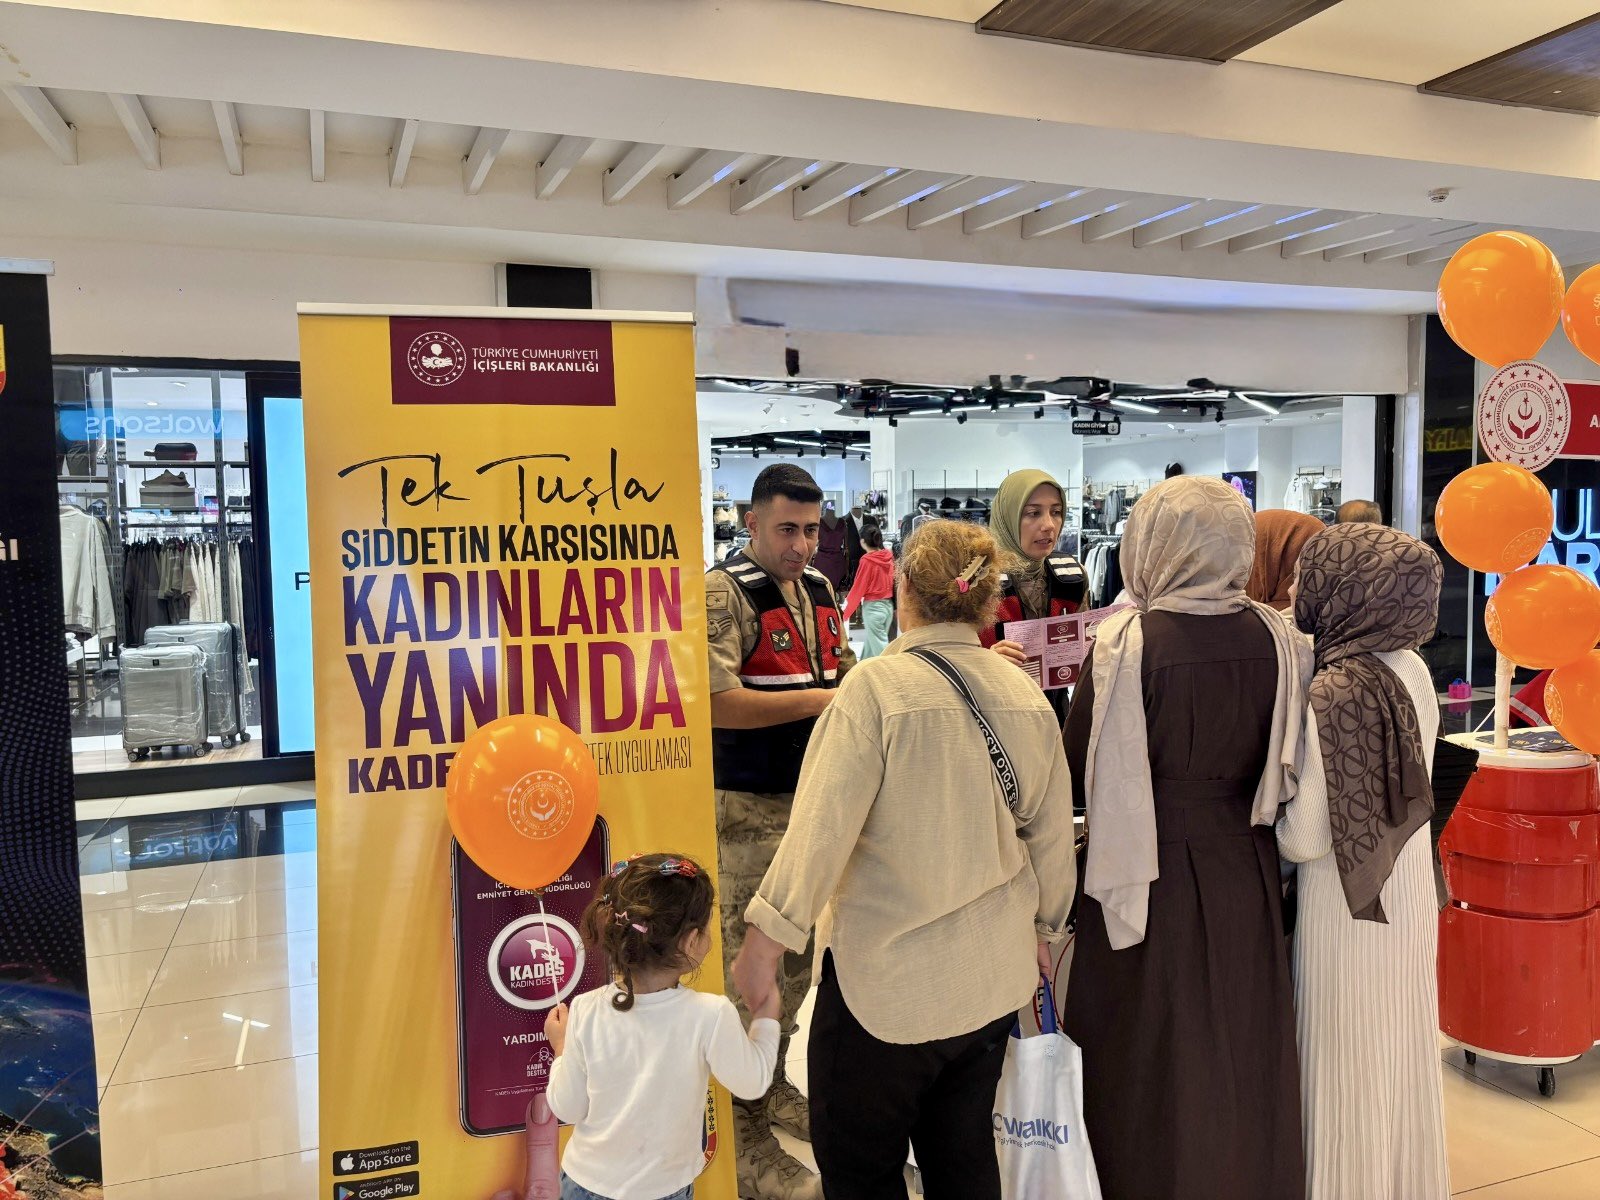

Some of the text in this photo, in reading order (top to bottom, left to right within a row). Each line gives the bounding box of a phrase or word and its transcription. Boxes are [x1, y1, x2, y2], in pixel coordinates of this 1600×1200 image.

[472, 346, 599, 360] TÜRKİYE CUMHURİYETİ
[473, 359, 599, 373] İÇİŞLERİ BAKANLIĞI
[338, 447, 665, 528] Tek Tuşla
[498, 524, 680, 564] KARŞISINDA
[343, 566, 683, 647] KADINLARIN
[346, 638, 687, 750] YANINDA
[615, 735, 692, 774] UYGULAMASI
[996, 757, 1015, 793] POLO
[477, 890, 512, 900] EMNİYET
[510, 960, 565, 981] KADES
[510, 975, 565, 989] KADIN DESTEK
[526, 1062, 543, 1071] KADIN
[526, 1069, 547, 1077] DESTEK
[359, 1149, 391, 1159] Download
[359, 1153, 412, 1171] App Store
[358, 1183, 415, 1199] Google Play
